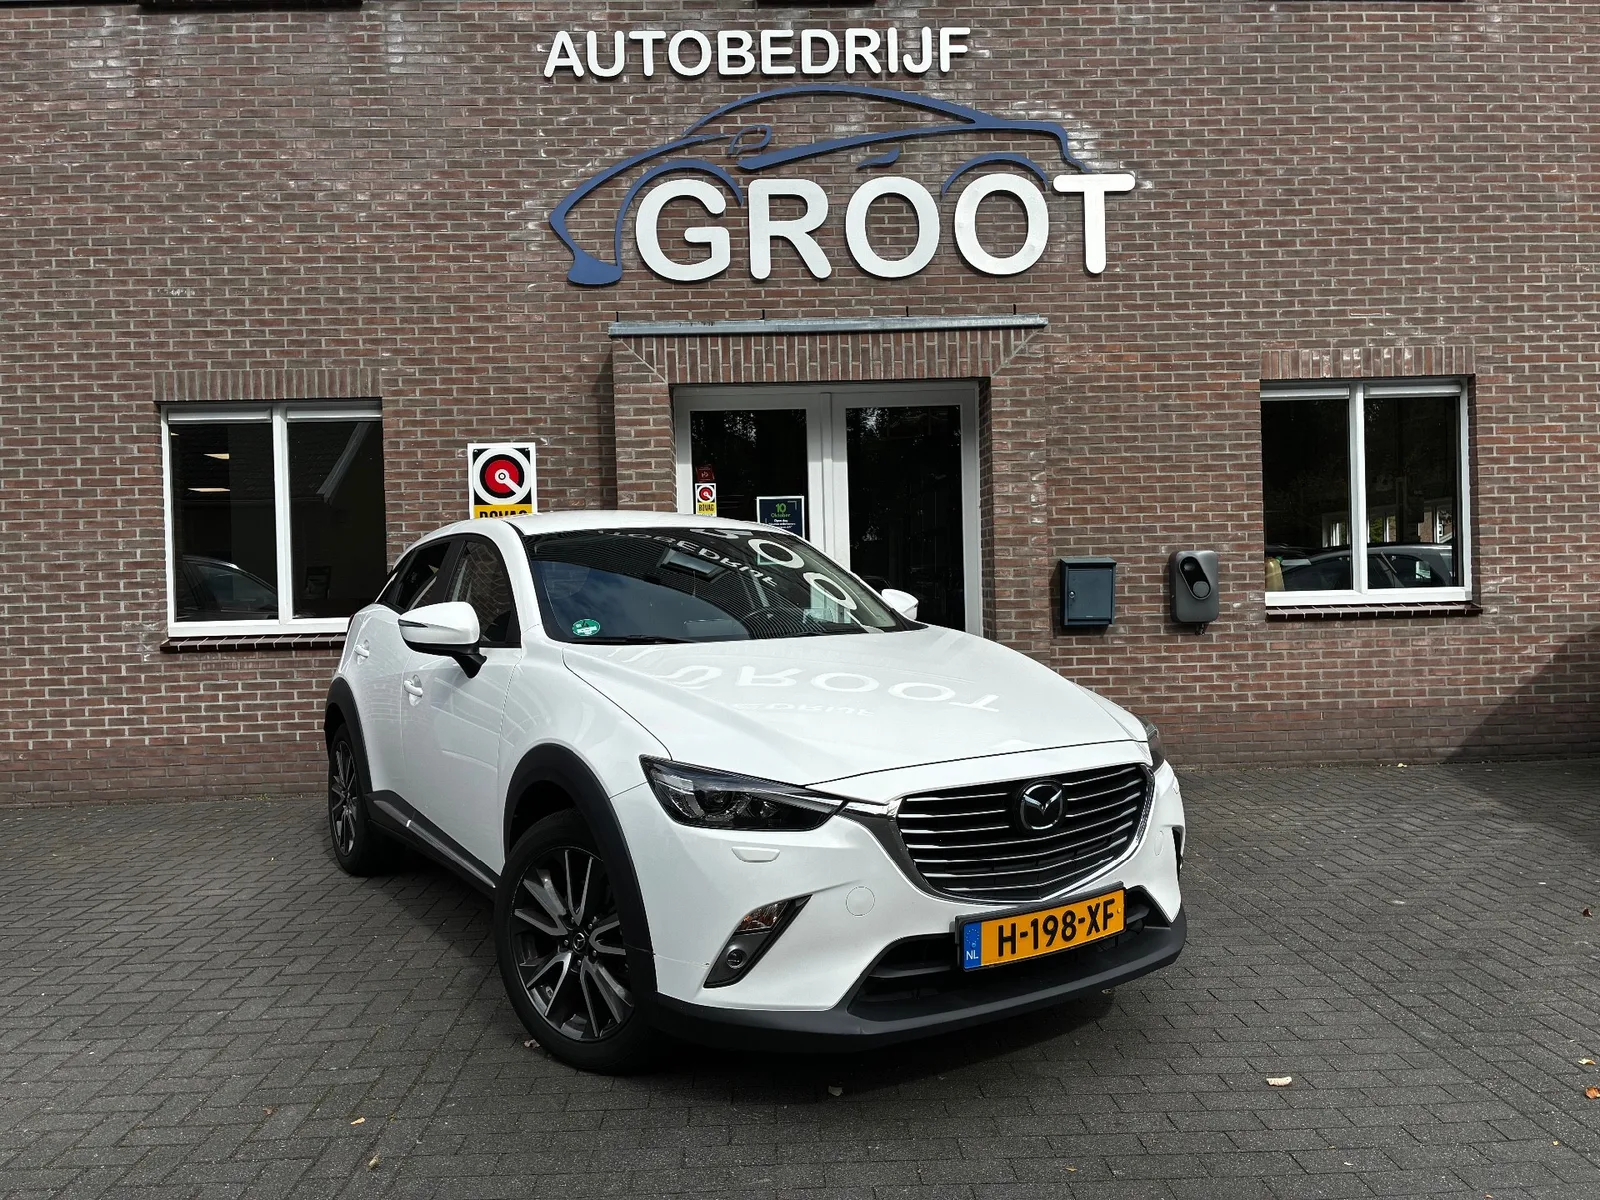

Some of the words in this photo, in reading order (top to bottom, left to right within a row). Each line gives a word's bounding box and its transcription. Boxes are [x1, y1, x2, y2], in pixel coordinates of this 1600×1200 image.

[544, 27, 971, 78] AUTOBEDRIJF
[635, 173, 1136, 282] GROOT
[776, 503, 787, 513] 10
[998, 898, 1116, 957] H-198-XF
[966, 950, 979, 961] NL
